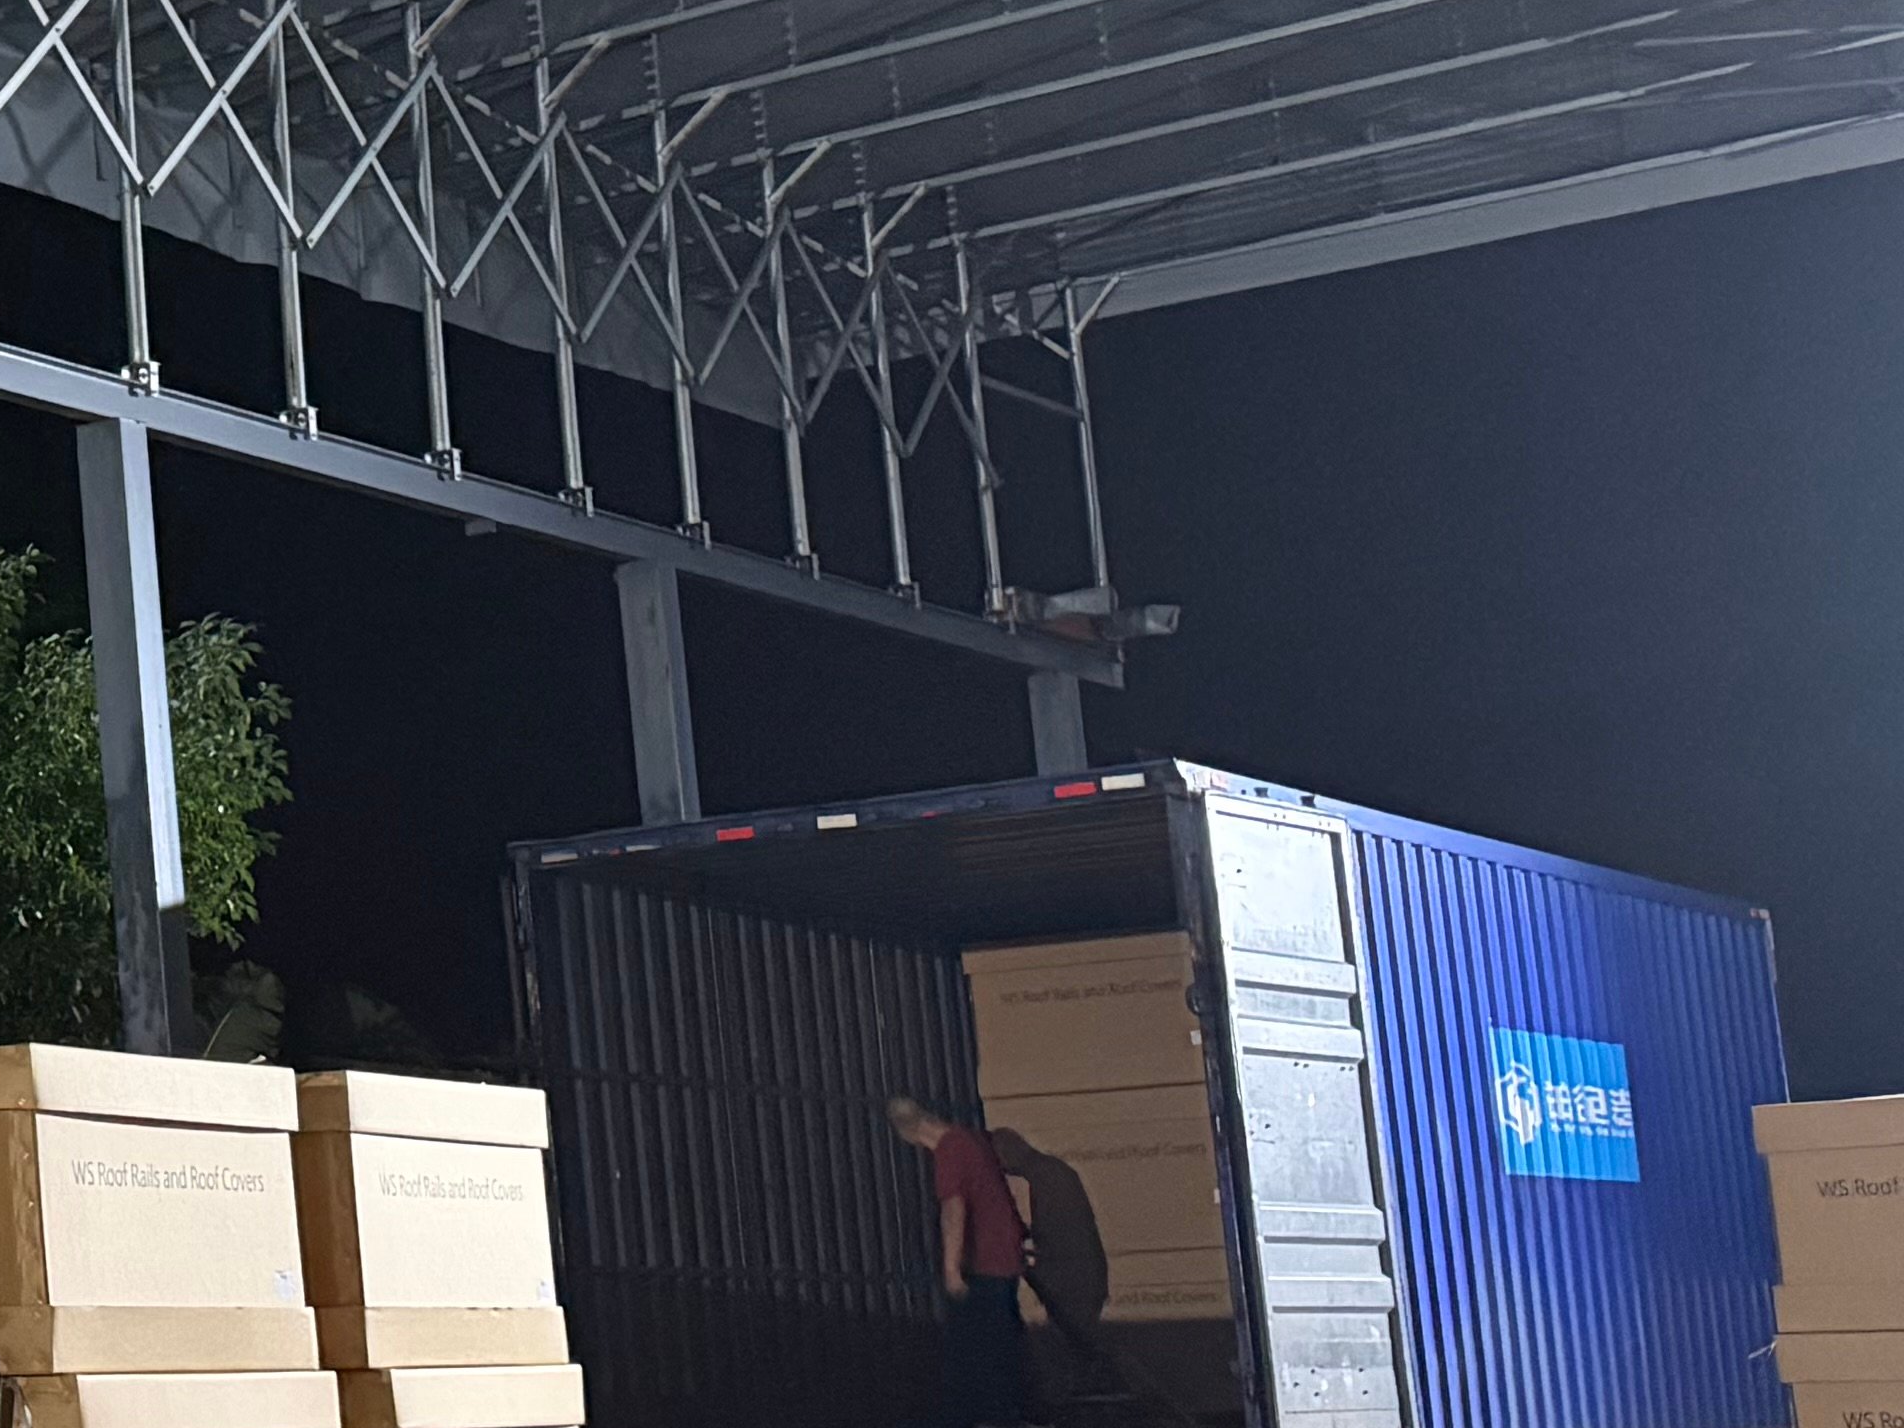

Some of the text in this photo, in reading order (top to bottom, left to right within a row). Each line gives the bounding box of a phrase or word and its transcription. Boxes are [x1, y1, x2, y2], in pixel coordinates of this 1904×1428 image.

[71, 1160, 264, 1192] WS Roof Rails and Roof Covers
[1816, 1179, 1849, 1197] WS
